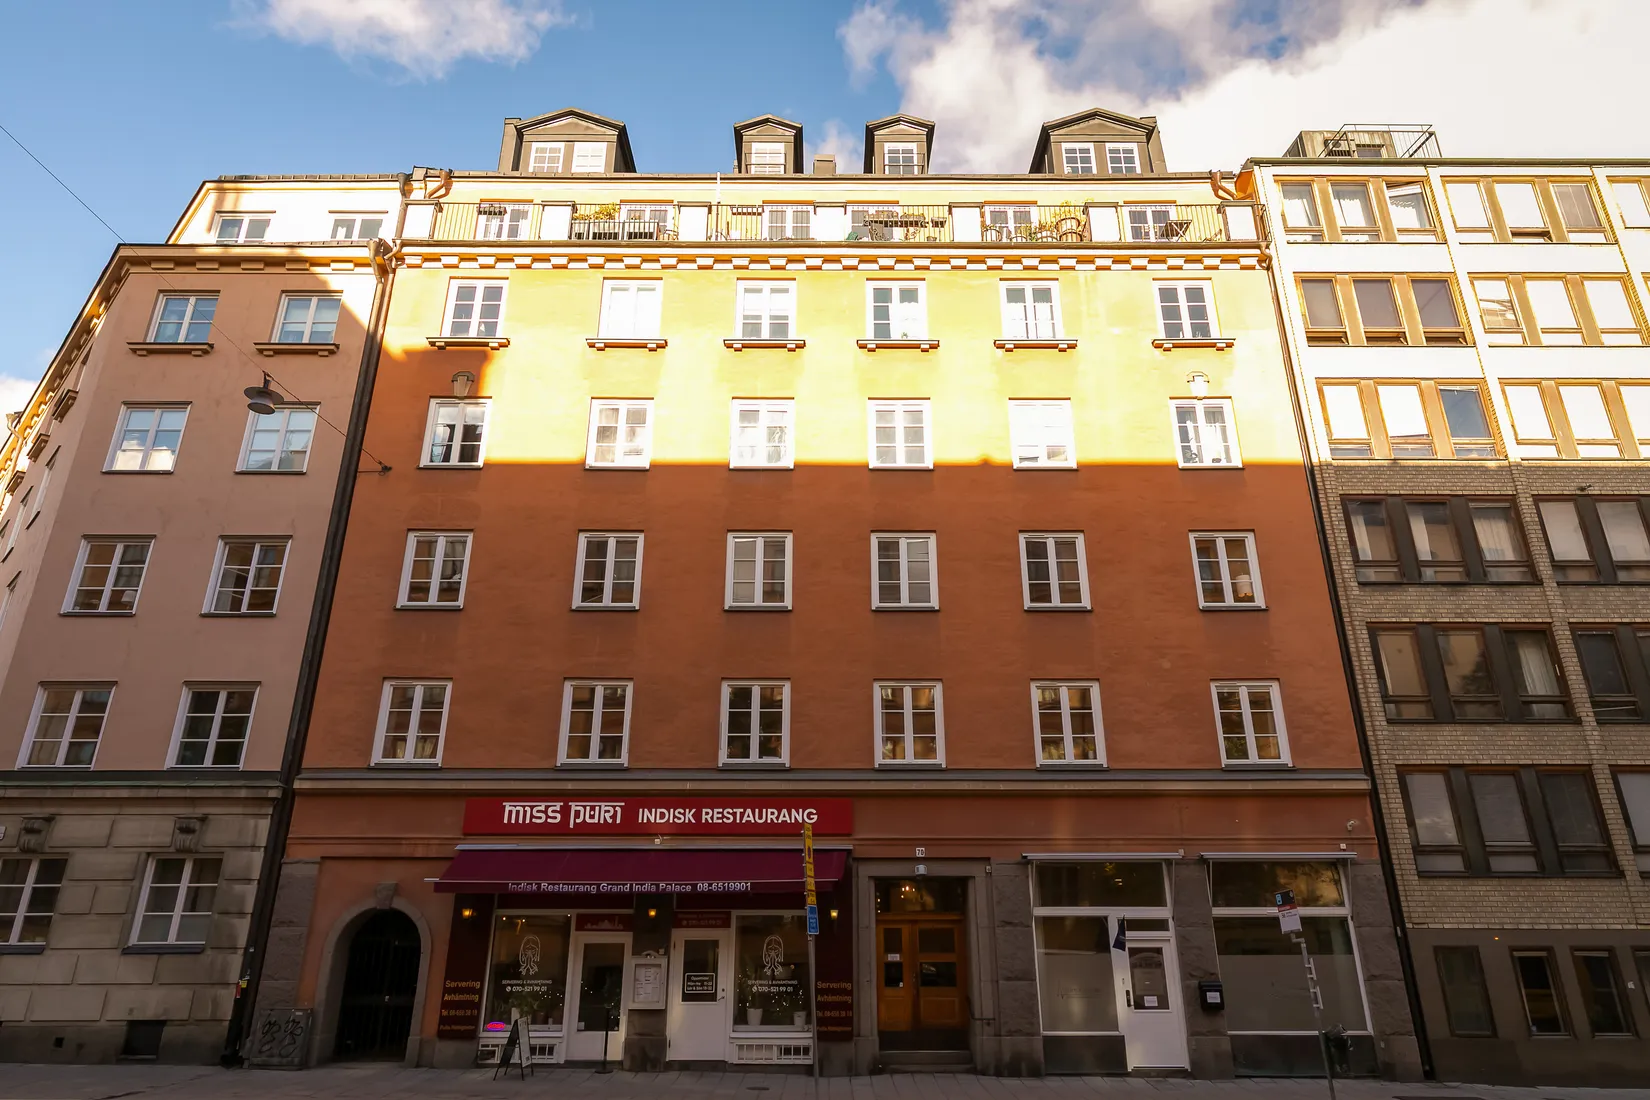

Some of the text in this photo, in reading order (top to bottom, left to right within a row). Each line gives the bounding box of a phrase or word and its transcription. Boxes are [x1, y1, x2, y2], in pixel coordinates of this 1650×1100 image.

[638, 808, 818, 824] INDISK RESTAURANG
[508, 882, 751, 894] Indisk Restaurang Grand India Palace 08-6519901
[445, 980, 481, 989] Servering
[817, 981, 852, 990] Servering
[444, 992, 479, 1002] Avhämtning
[817, 994, 852, 1004] Avhämtning
